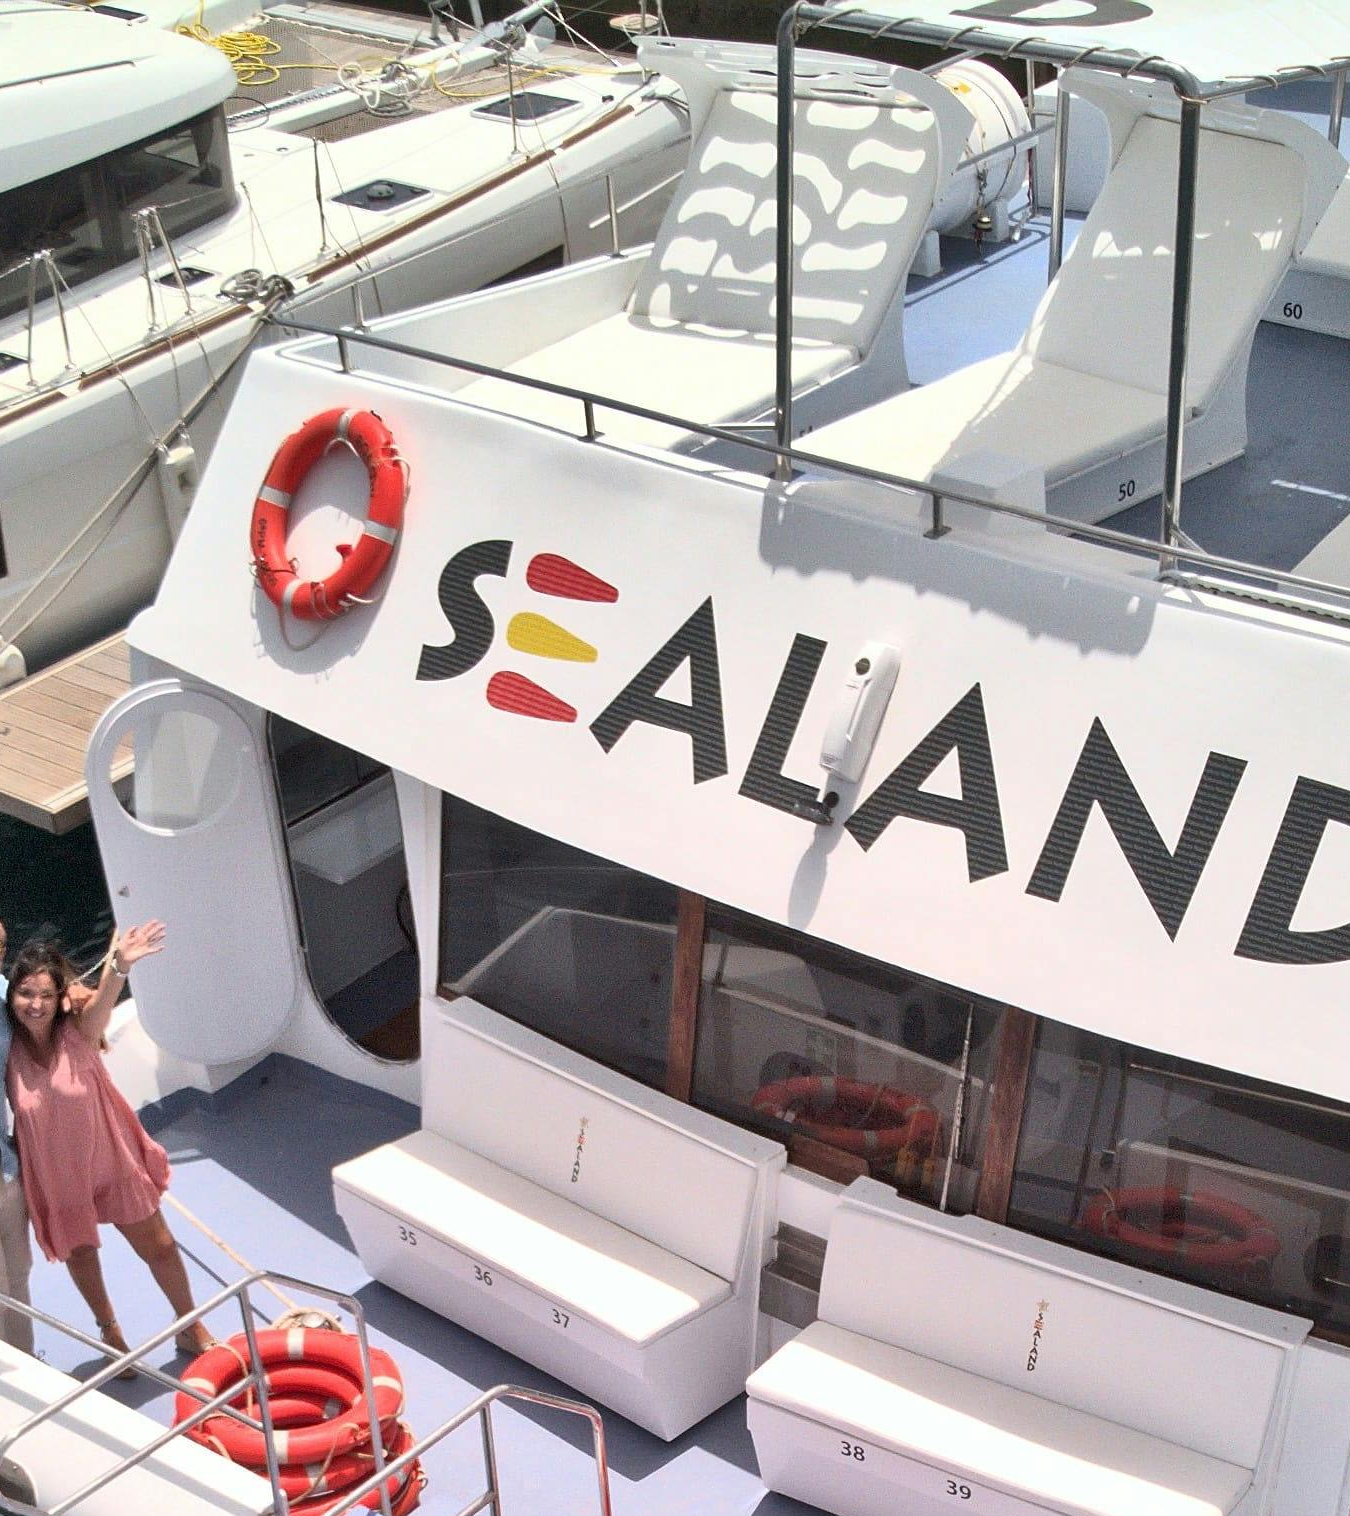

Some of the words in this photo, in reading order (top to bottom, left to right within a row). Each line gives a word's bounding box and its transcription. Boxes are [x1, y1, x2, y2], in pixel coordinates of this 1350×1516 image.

[1282, 302, 1303, 320] 60
[1118, 480, 1136, 502] 50
[398, 1225, 418, 1247] 35
[473, 1264, 494, 1287] 36
[551, 1307, 571, 1329] 37
[1026, 1312, 1044, 1371] SEALAND
[840, 1439, 866, 1463] 38
[945, 1478, 972, 1501] 39
